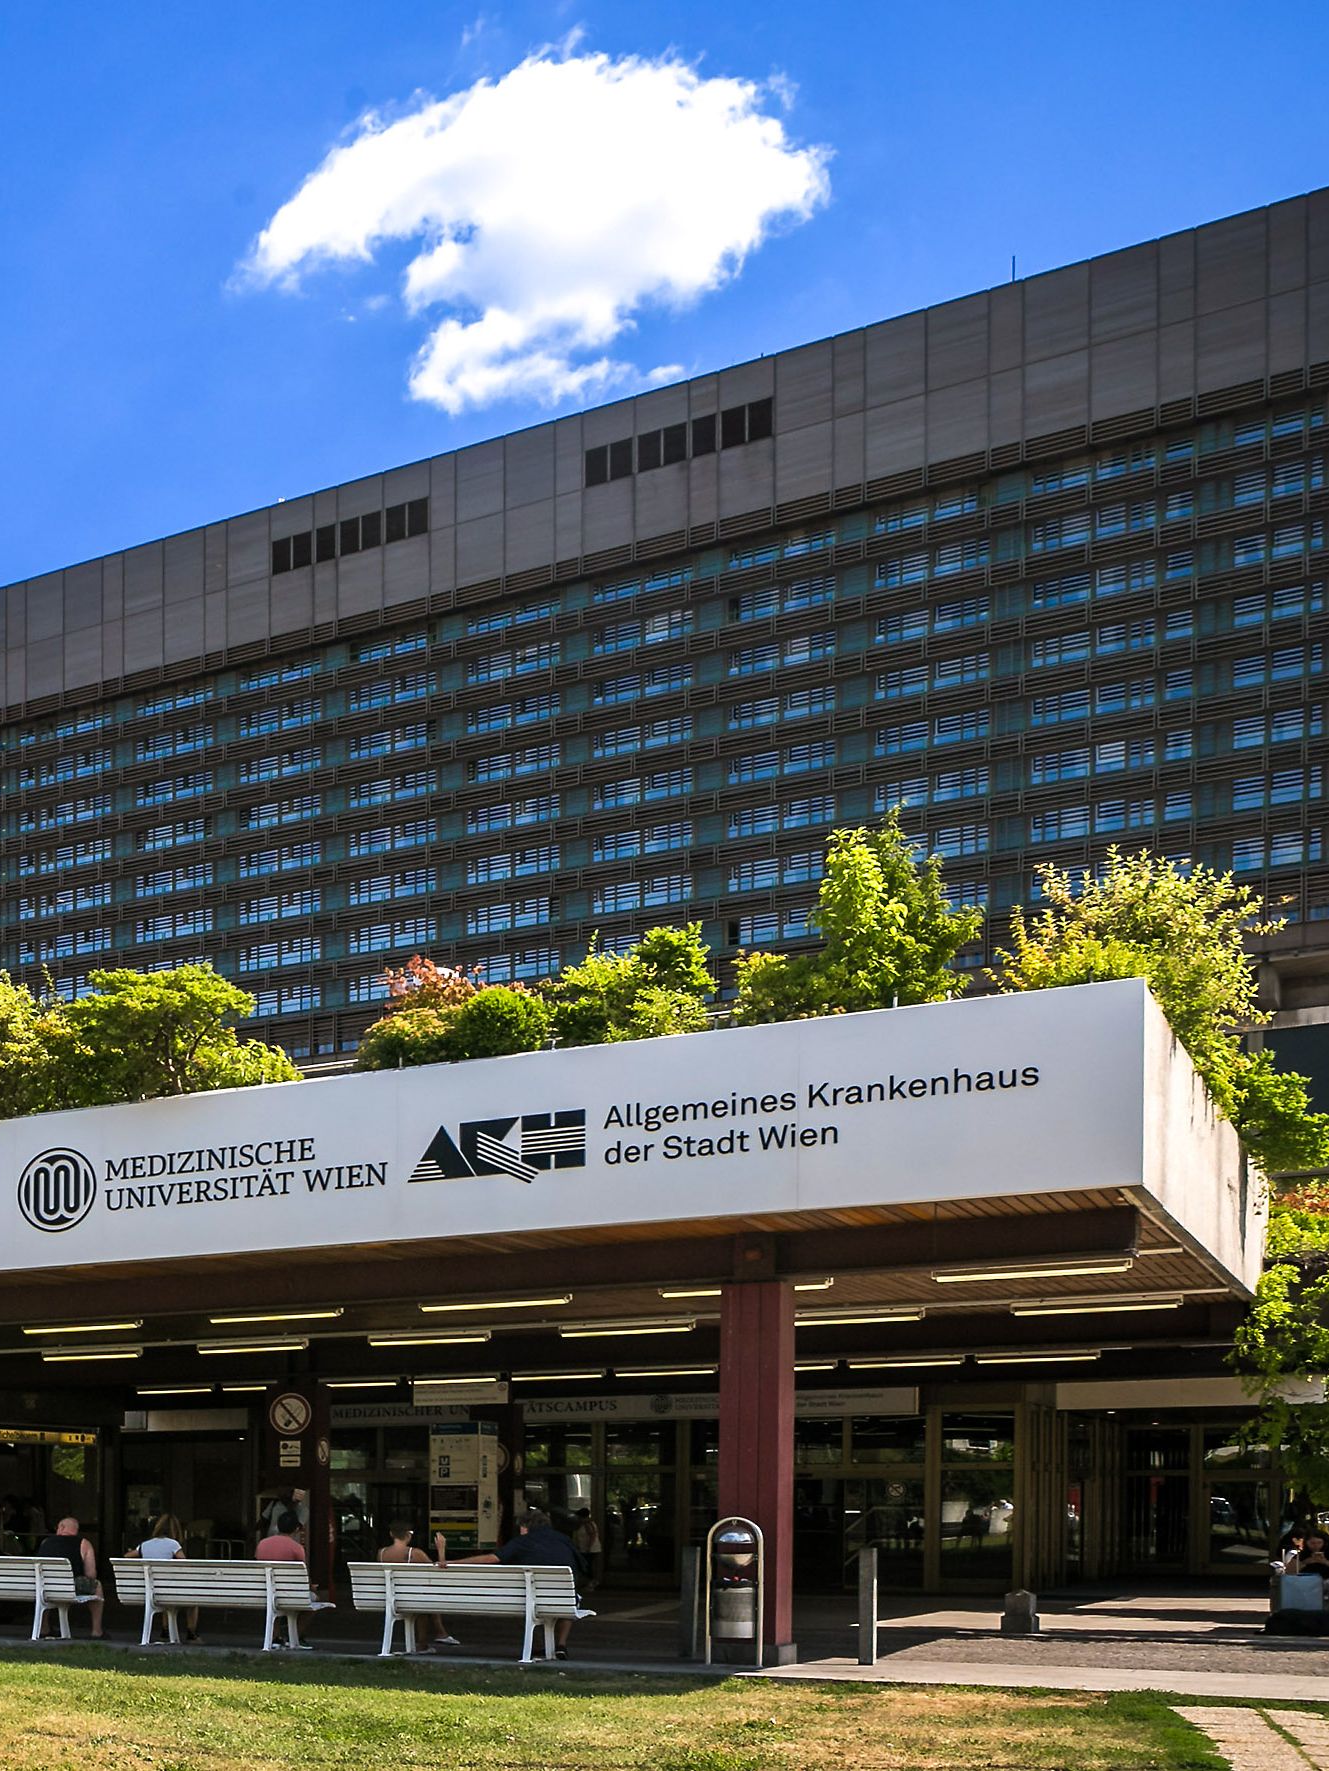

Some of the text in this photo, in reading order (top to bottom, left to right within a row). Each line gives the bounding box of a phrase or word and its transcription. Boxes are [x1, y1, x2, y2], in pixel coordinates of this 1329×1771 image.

[603, 1066, 1040, 1132] Allgemeines Krankenhaus
[104, 1137, 316, 1182] MEDIZINISCHE
[407, 1108, 586, 1184] AKH
[604, 1123, 839, 1165] der Stadt Wien
[104, 1161, 389, 1212] UNIVERSITÄT WIEN
